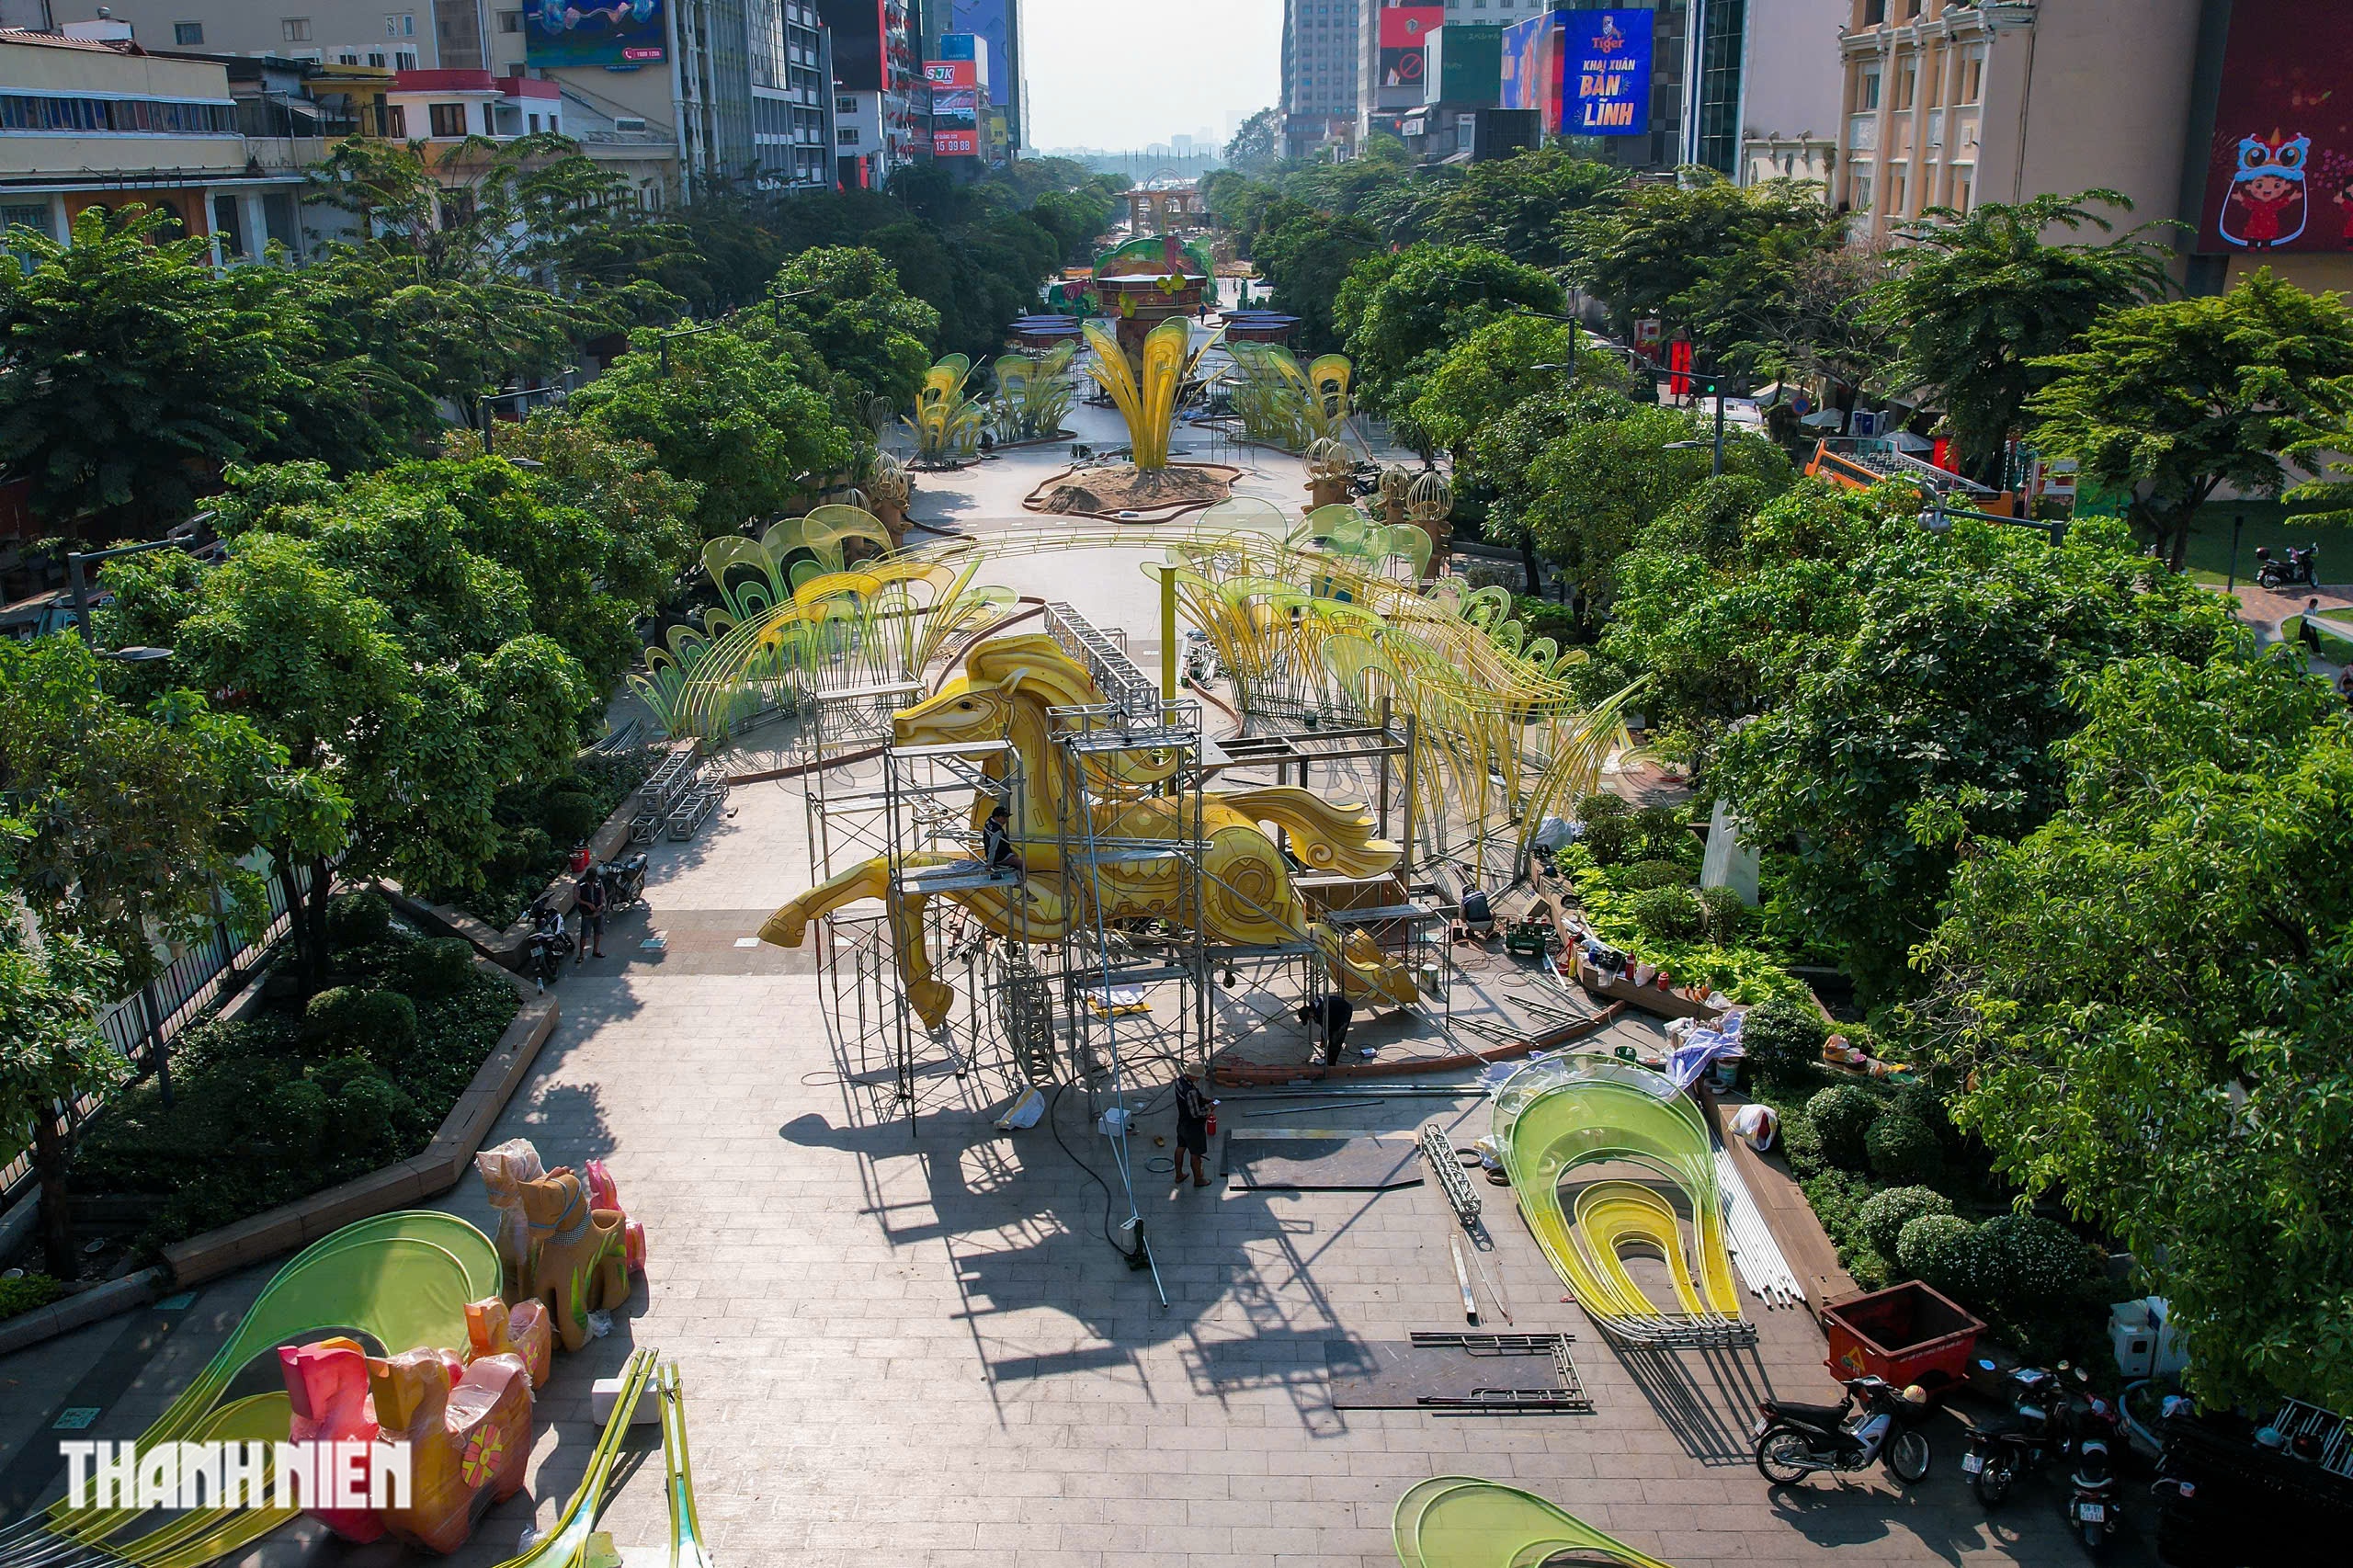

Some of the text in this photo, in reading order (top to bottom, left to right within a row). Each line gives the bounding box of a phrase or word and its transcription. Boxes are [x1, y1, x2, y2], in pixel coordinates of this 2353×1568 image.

[1592, 37, 1625, 54] Tiger
[1583, 56, 1636, 71] KHAI XUÂN
[926, 68, 953, 80] SJK
[1579, 69, 1621, 97] BẢN
[1583, 97, 1634, 126] LĨNH
[949, 141, 958, 151] 99
[960, 141, 970, 151] 88
